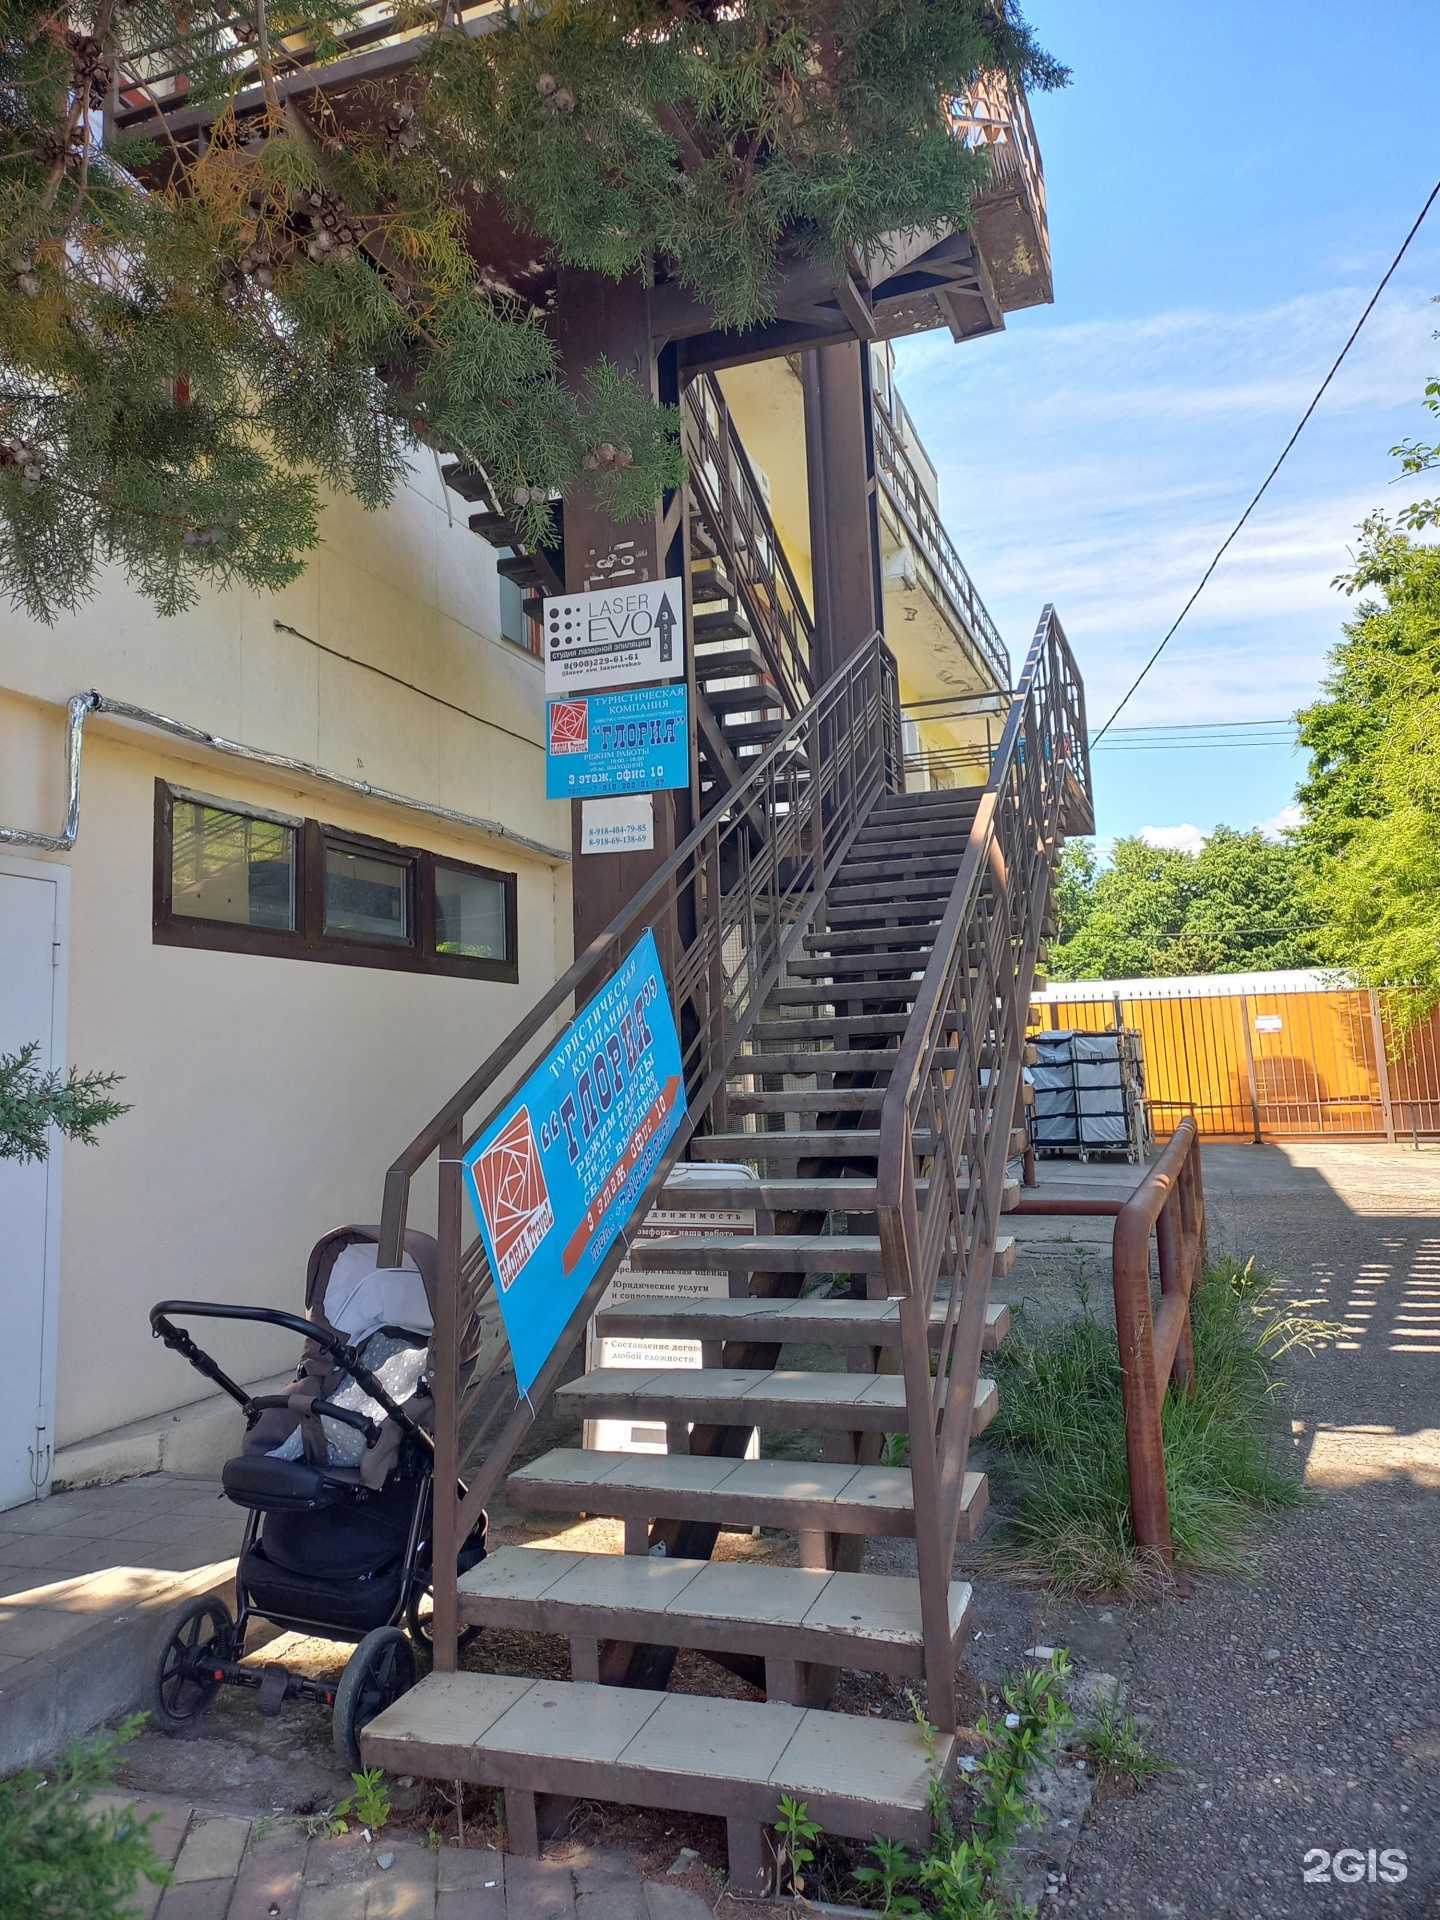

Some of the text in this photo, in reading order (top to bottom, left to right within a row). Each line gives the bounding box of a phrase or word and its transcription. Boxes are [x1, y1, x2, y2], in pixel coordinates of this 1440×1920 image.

[588, 593, 649, 618] LASER
[661, 611, 669, 620] 3
[588, 610, 653, 643] EVO
[595, 687, 685, 706] ТУРИСТИЧЕСКАЯ
[608, 699, 669, 714] КОМПАНИЯ
[584, 747, 650, 761] РЕЖИМ РАБОТЫ
[568, 774, 575, 785] 3
[616, 769, 646, 782] офис
[650, 765, 665, 777] 10
[549, 960, 637, 1079] ТУРИСТИЧЕСКАЯ
[571, 994, 630, 1077] КОМПАНИЯ
[576, 1053, 655, 1179] РЕЖИМ РАБОТЫ
[587, 1211, 595, 1233] 3
[630, 1118, 653, 1159] офис
[654, 1094, 667, 1120] 10
[636, 1227, 671, 1238] омфорт
[499, 1233, 531, 1290] GLORIA
[612, 1280, 709, 1294] Юридические услуги
[611, 1340, 669, 1351] Составление
[611, 1351, 642, 1361] любой
